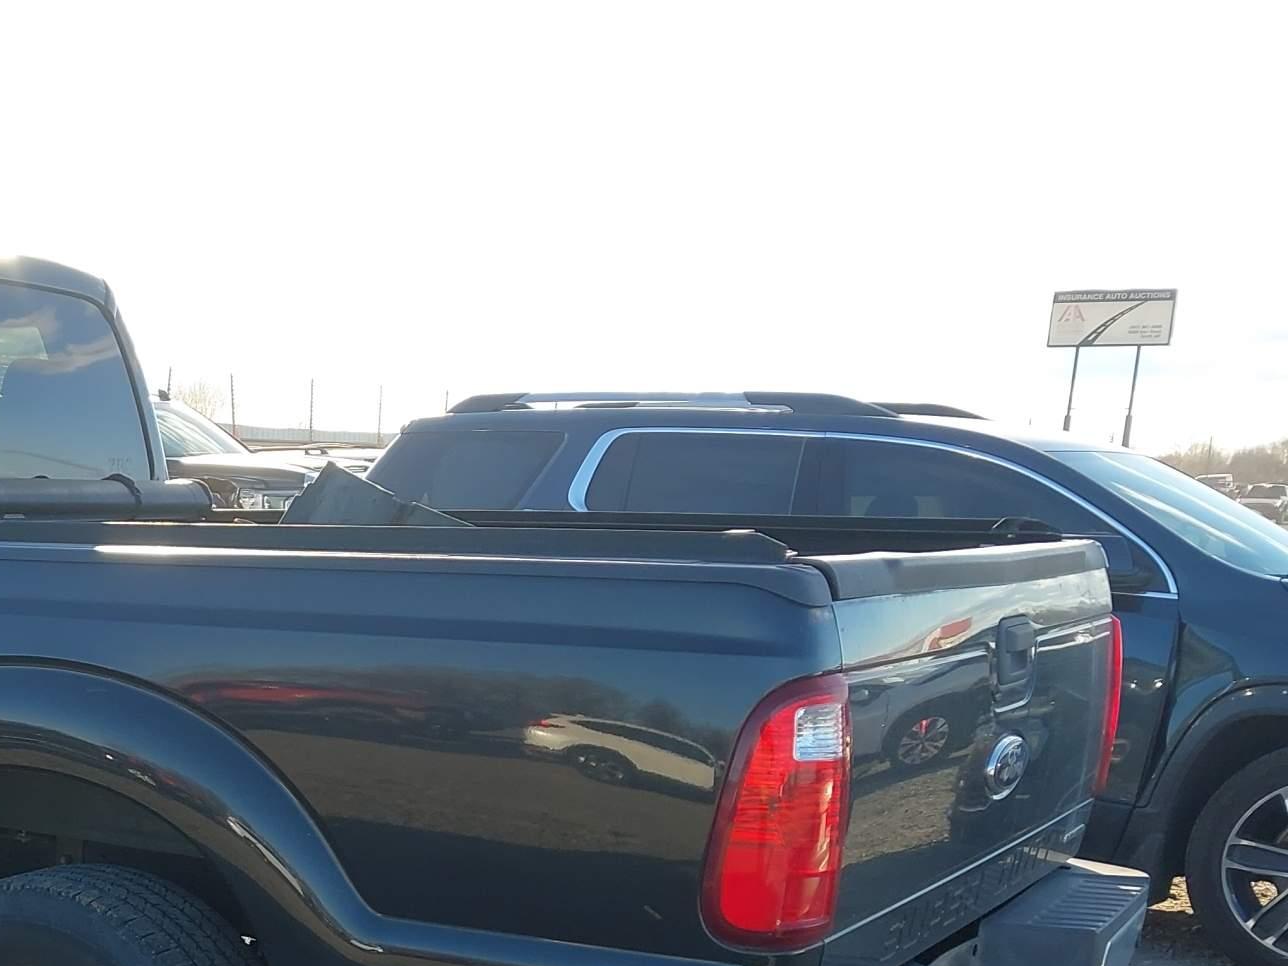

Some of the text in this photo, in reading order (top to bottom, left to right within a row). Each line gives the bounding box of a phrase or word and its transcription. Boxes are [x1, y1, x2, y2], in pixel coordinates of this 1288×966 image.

[1058, 291, 1171, 301] INSURANCE AUTO AUCTIONS
